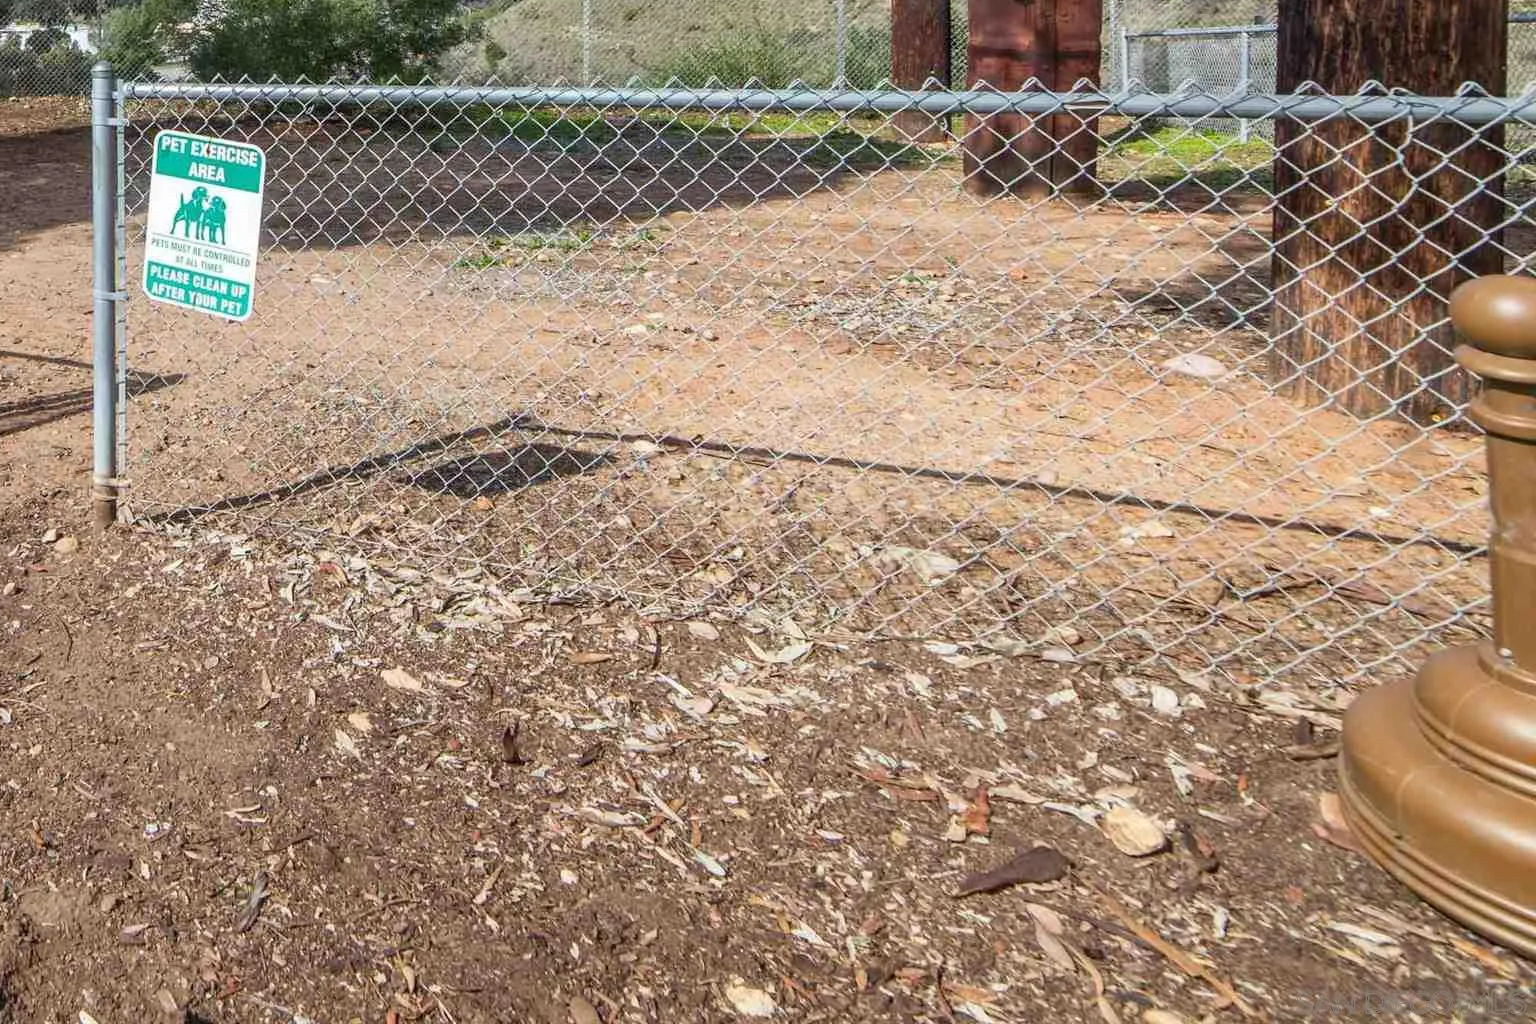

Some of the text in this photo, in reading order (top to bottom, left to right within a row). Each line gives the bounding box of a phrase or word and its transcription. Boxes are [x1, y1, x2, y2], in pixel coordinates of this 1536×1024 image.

[161, 136, 258, 167] PET EXERCISE
[188, 162, 225, 183] AREA
[151, 238, 251, 267] PETS MUST BE CONTROLLED
[176, 255, 223, 274] AT ALL TIMES
[150, 264, 247, 298] PLEASE CLEAN UP
[151, 282, 242, 316] AFTER YOUR PET
